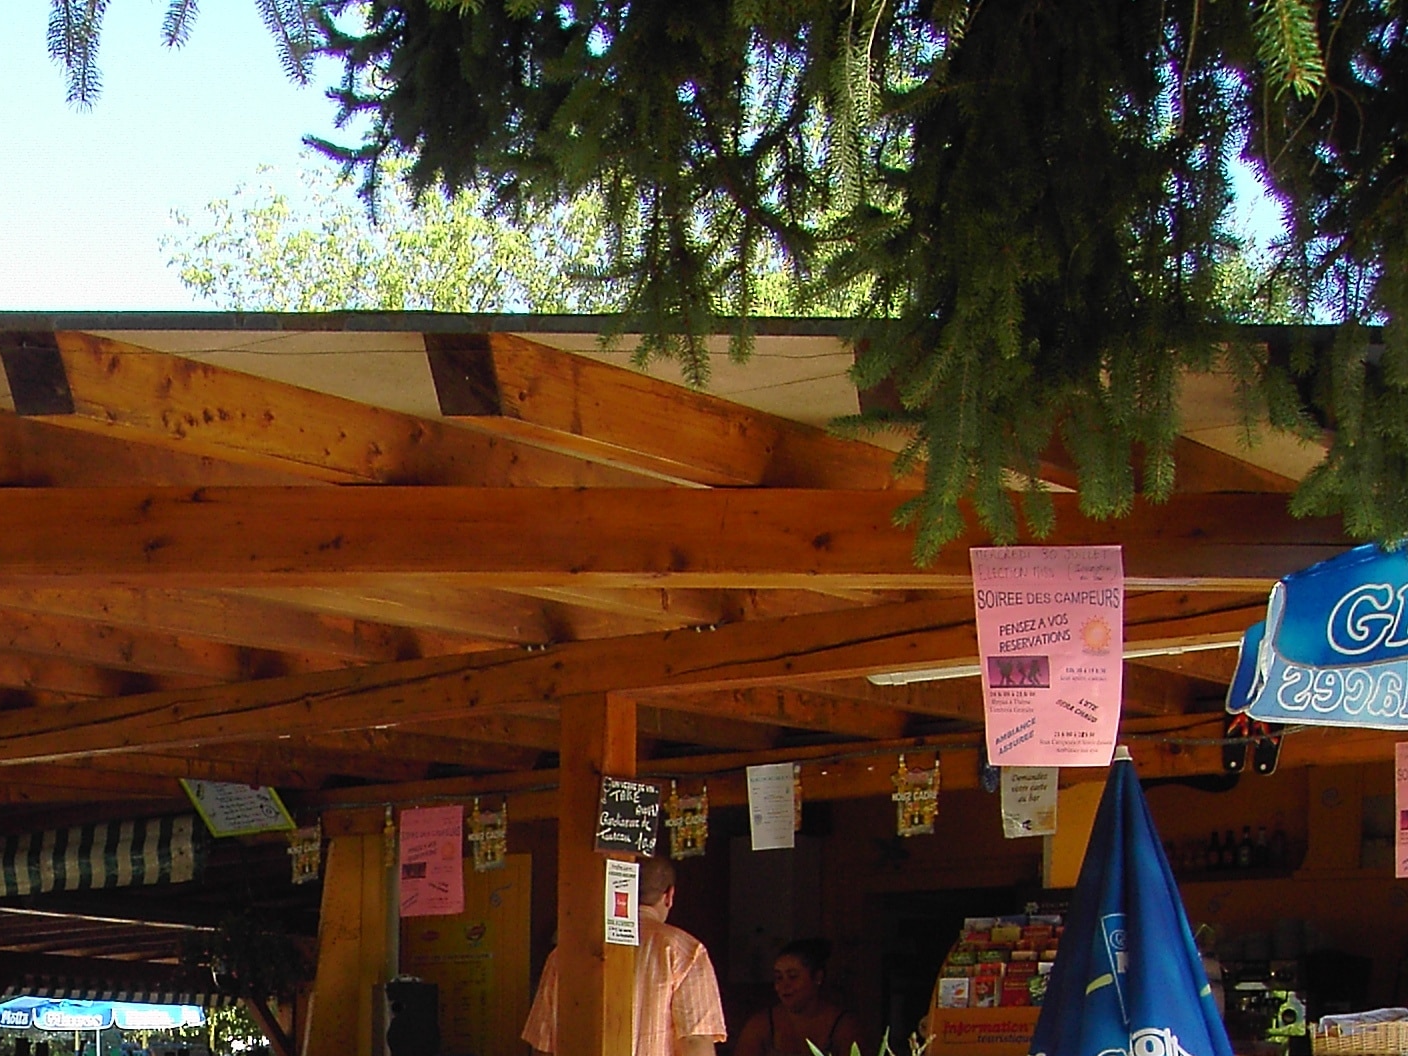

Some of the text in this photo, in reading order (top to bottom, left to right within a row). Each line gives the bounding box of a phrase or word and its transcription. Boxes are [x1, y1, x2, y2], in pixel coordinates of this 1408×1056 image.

[978, 588, 1121, 609] SOIREE DES CAMPEURS
[999, 619, 1037, 637] PENSEZ
[1048, 613, 1070, 627] VOS
[999, 629, 1072, 654] RESERVATIONS
[995, 717, 1037, 746] AMBIANCE
